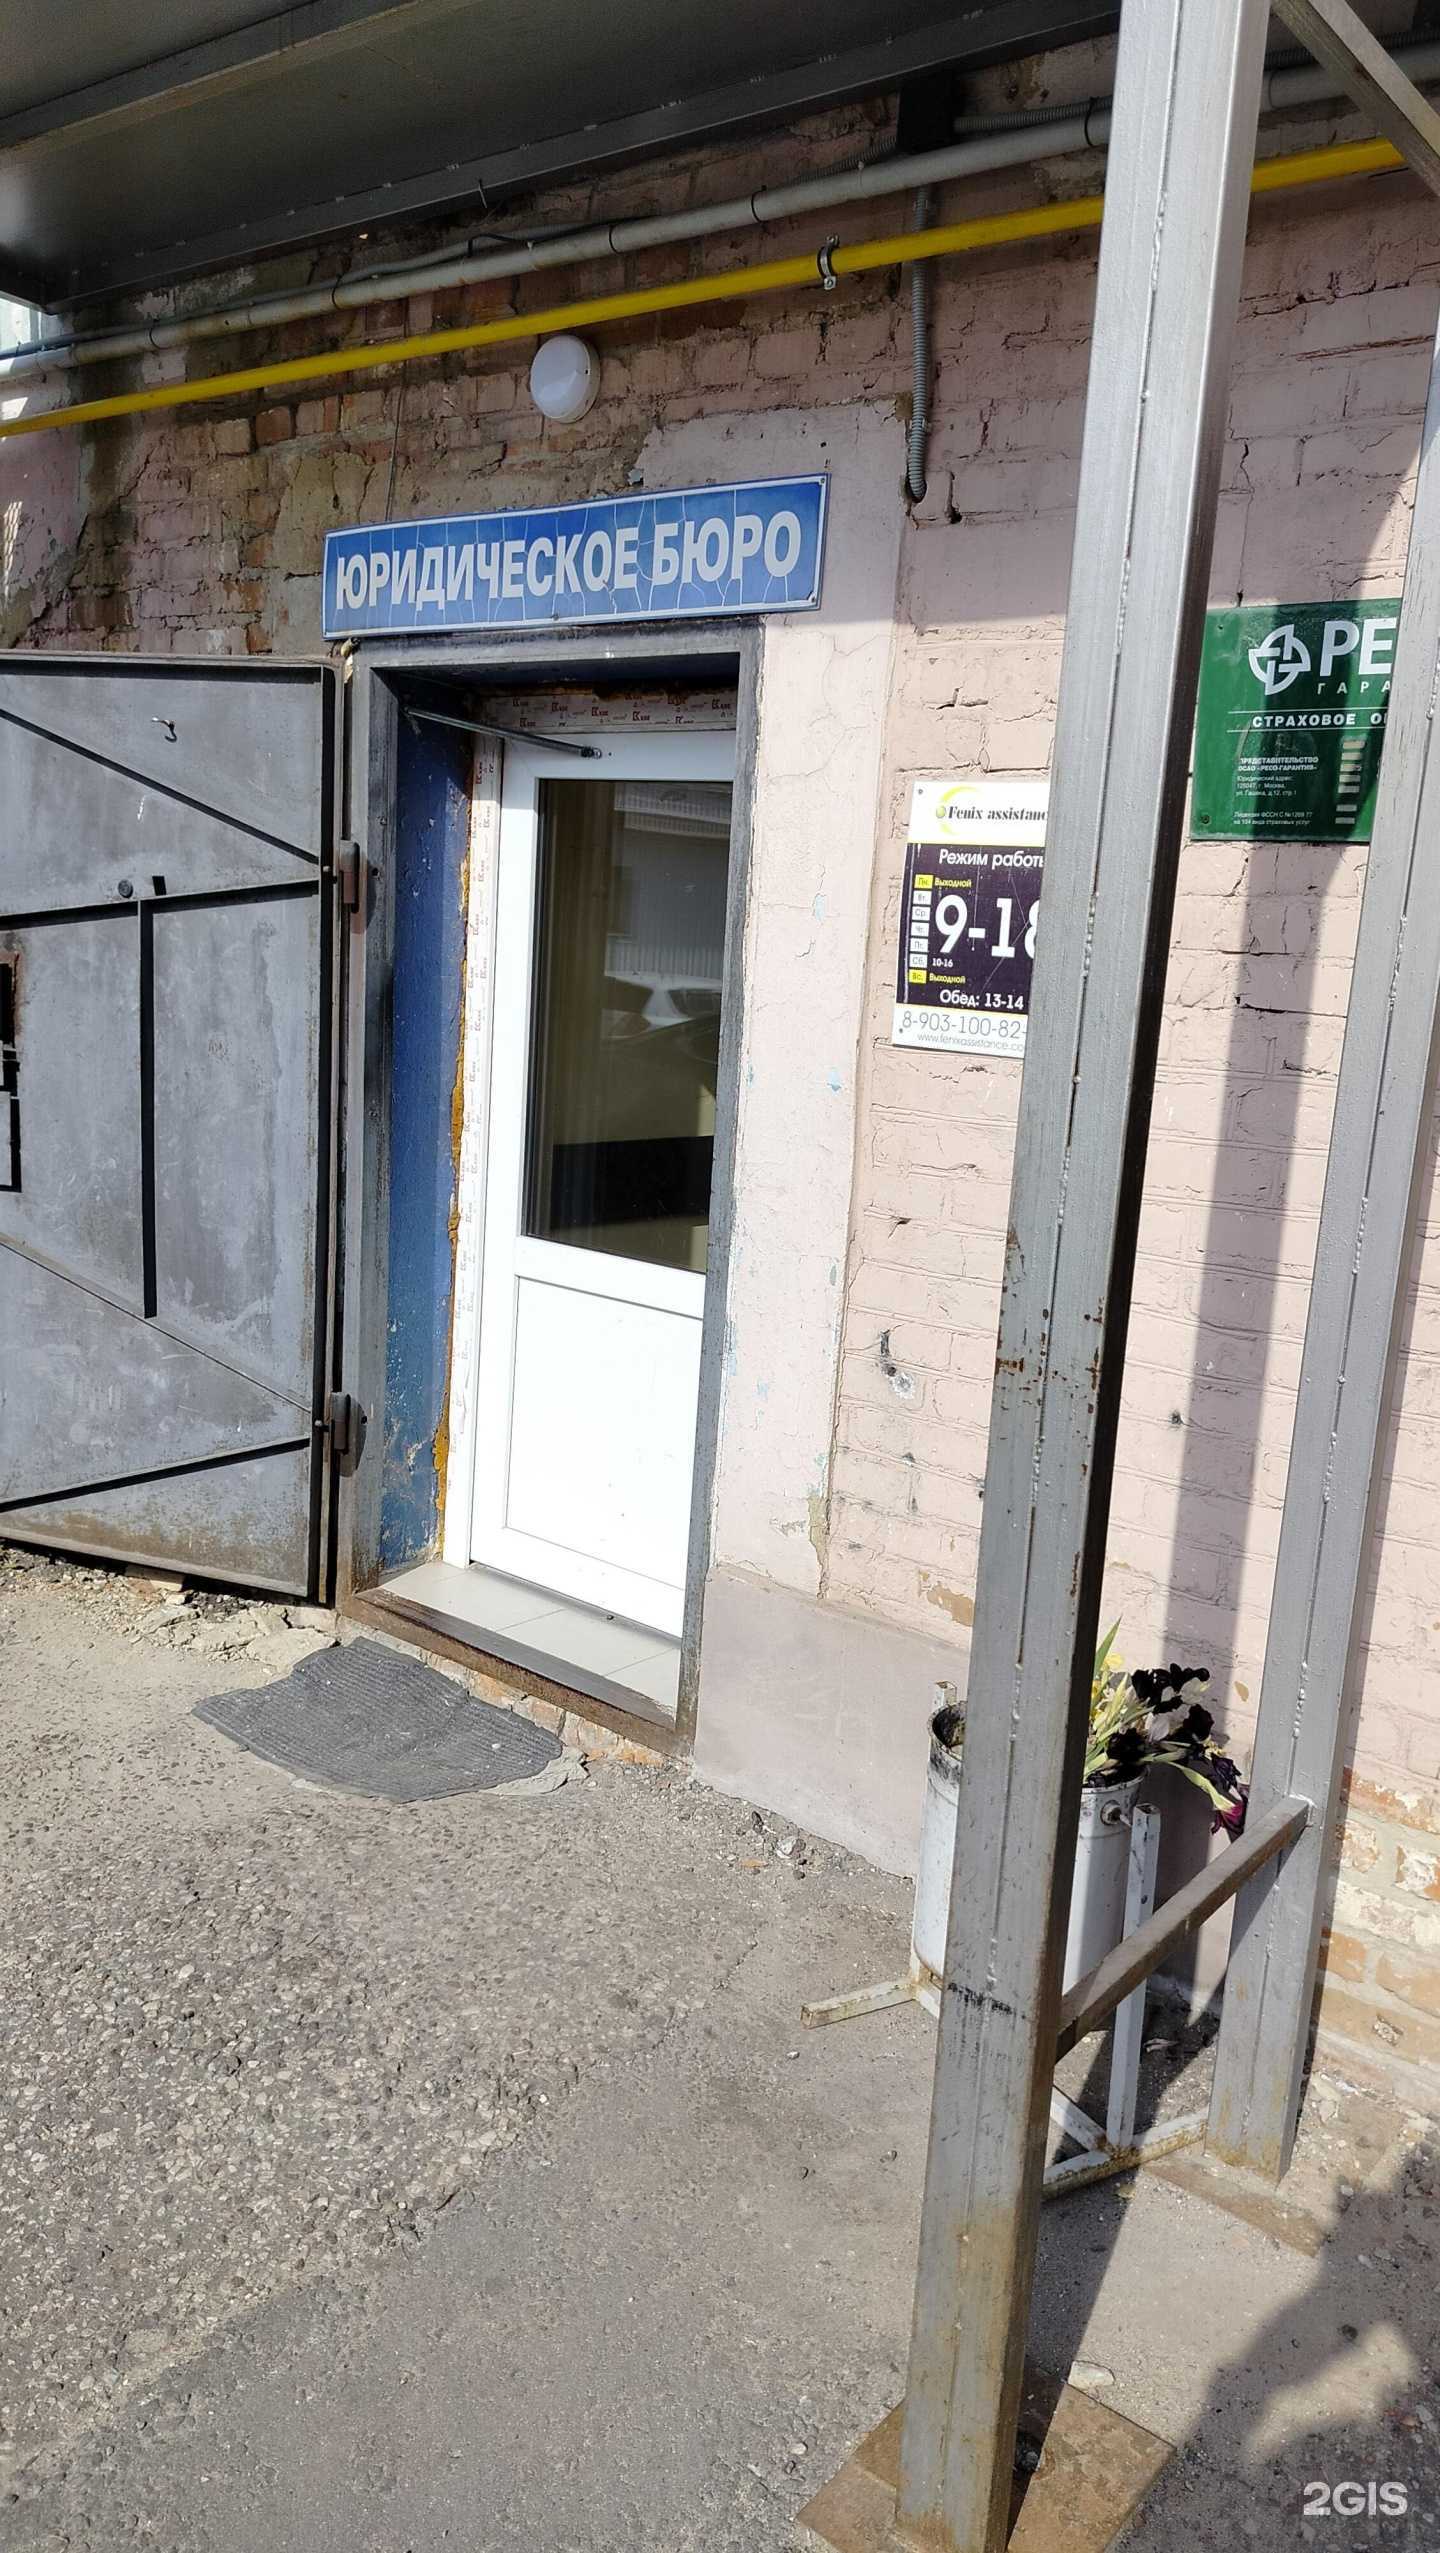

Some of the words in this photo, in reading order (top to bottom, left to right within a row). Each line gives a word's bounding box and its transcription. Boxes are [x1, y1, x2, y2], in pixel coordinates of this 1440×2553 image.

[335, 526, 640, 612] ЮРИДИЧЕСКОЕ
[653, 509, 801, 585] БЮРО
[1319, 617, 1397, 677] РЕ
[1252, 713, 1356, 728] СТРАХОВОЕ
[1370, 712, 1388, 725] О
[948, 805, 983, 820] Fenix
[938, 848, 988, 866] Режим
[932, 958, 954, 968] 10-16
[940, 989, 980, 1006] Обед:
[984, 993, 1024, 1010] 13-14
